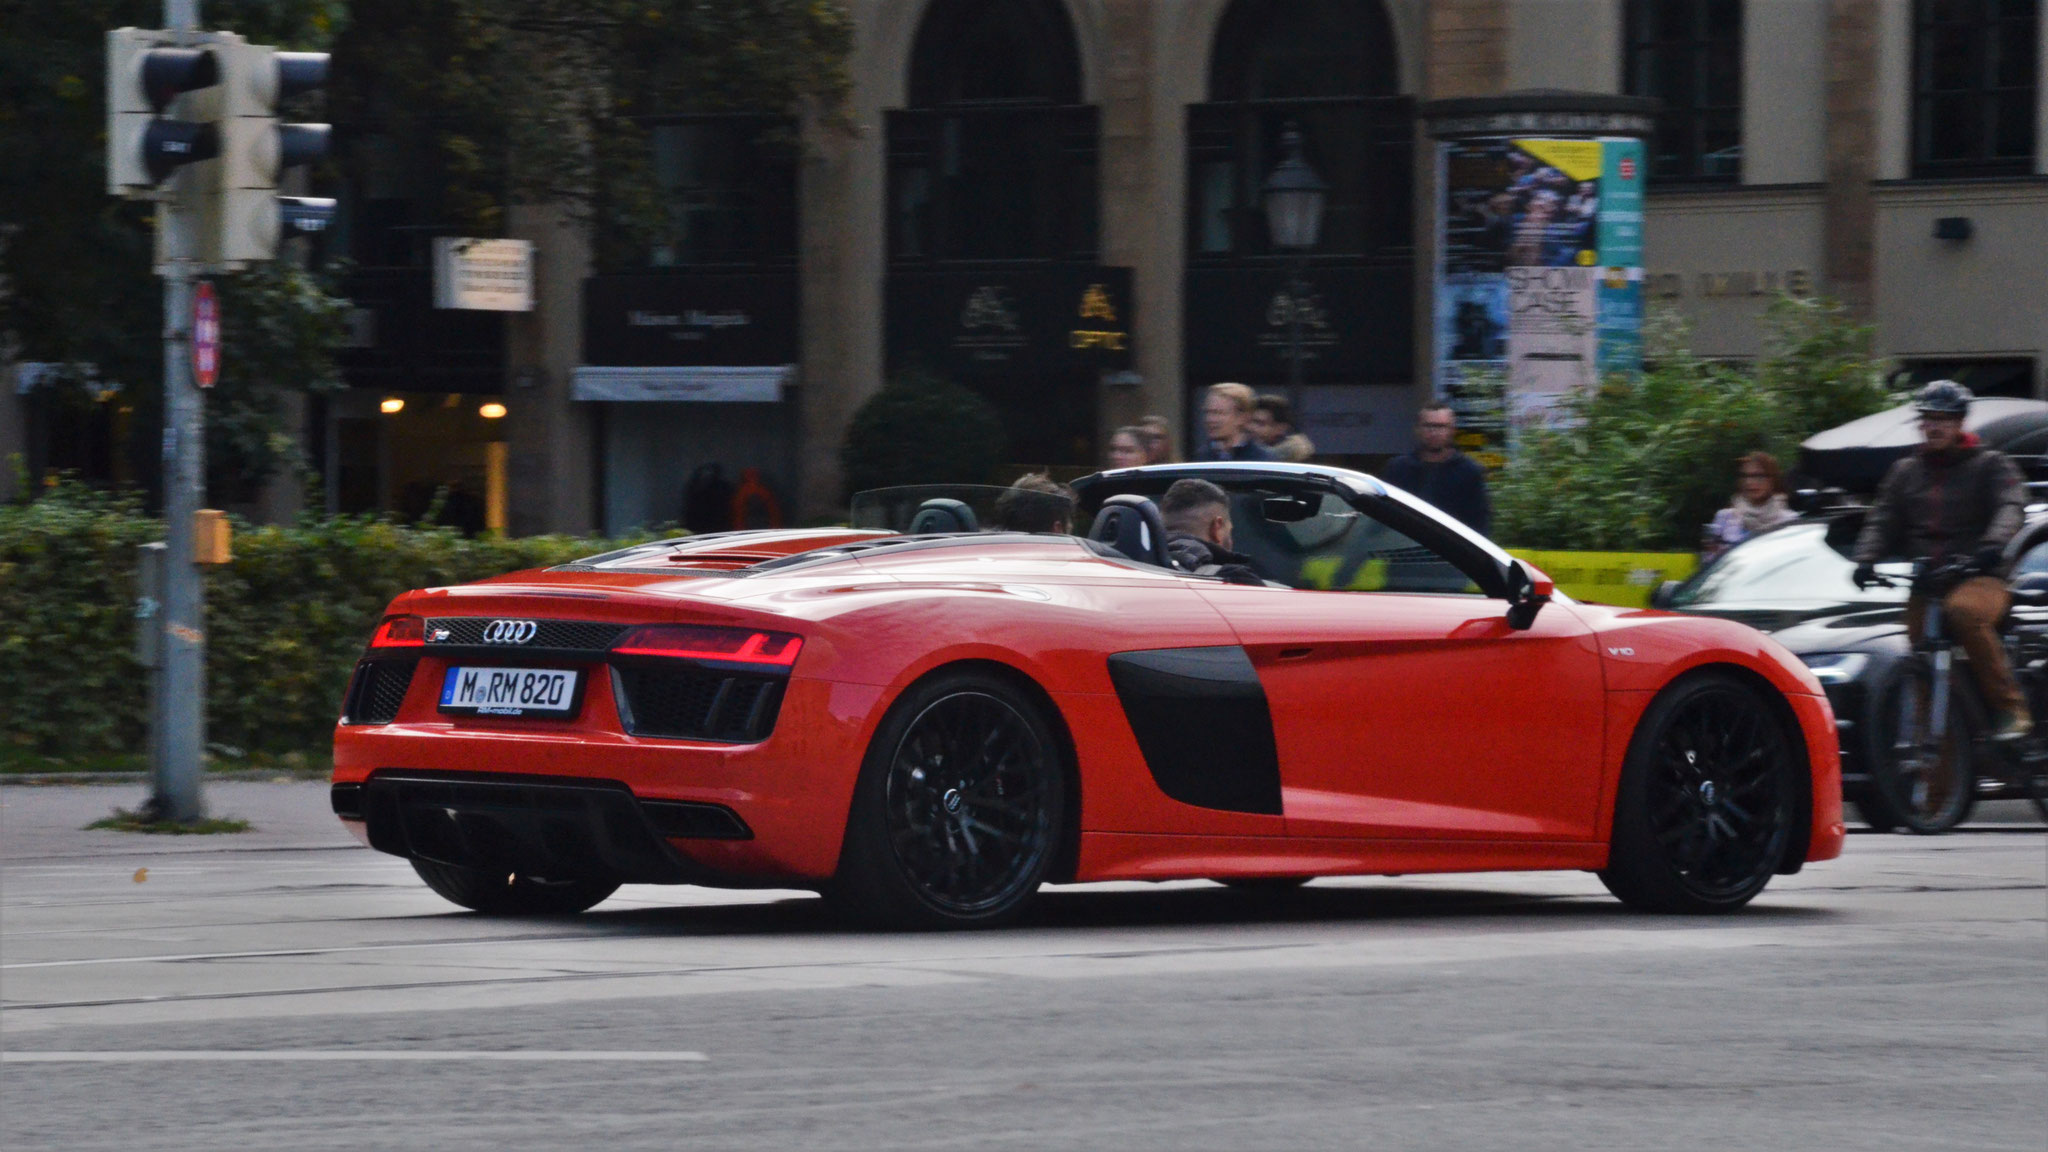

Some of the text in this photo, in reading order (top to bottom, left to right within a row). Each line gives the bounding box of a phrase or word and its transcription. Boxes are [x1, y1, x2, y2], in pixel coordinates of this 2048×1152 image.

[1607, 647, 1635, 656] V10
[460, 672, 565, 705] M RM 820
